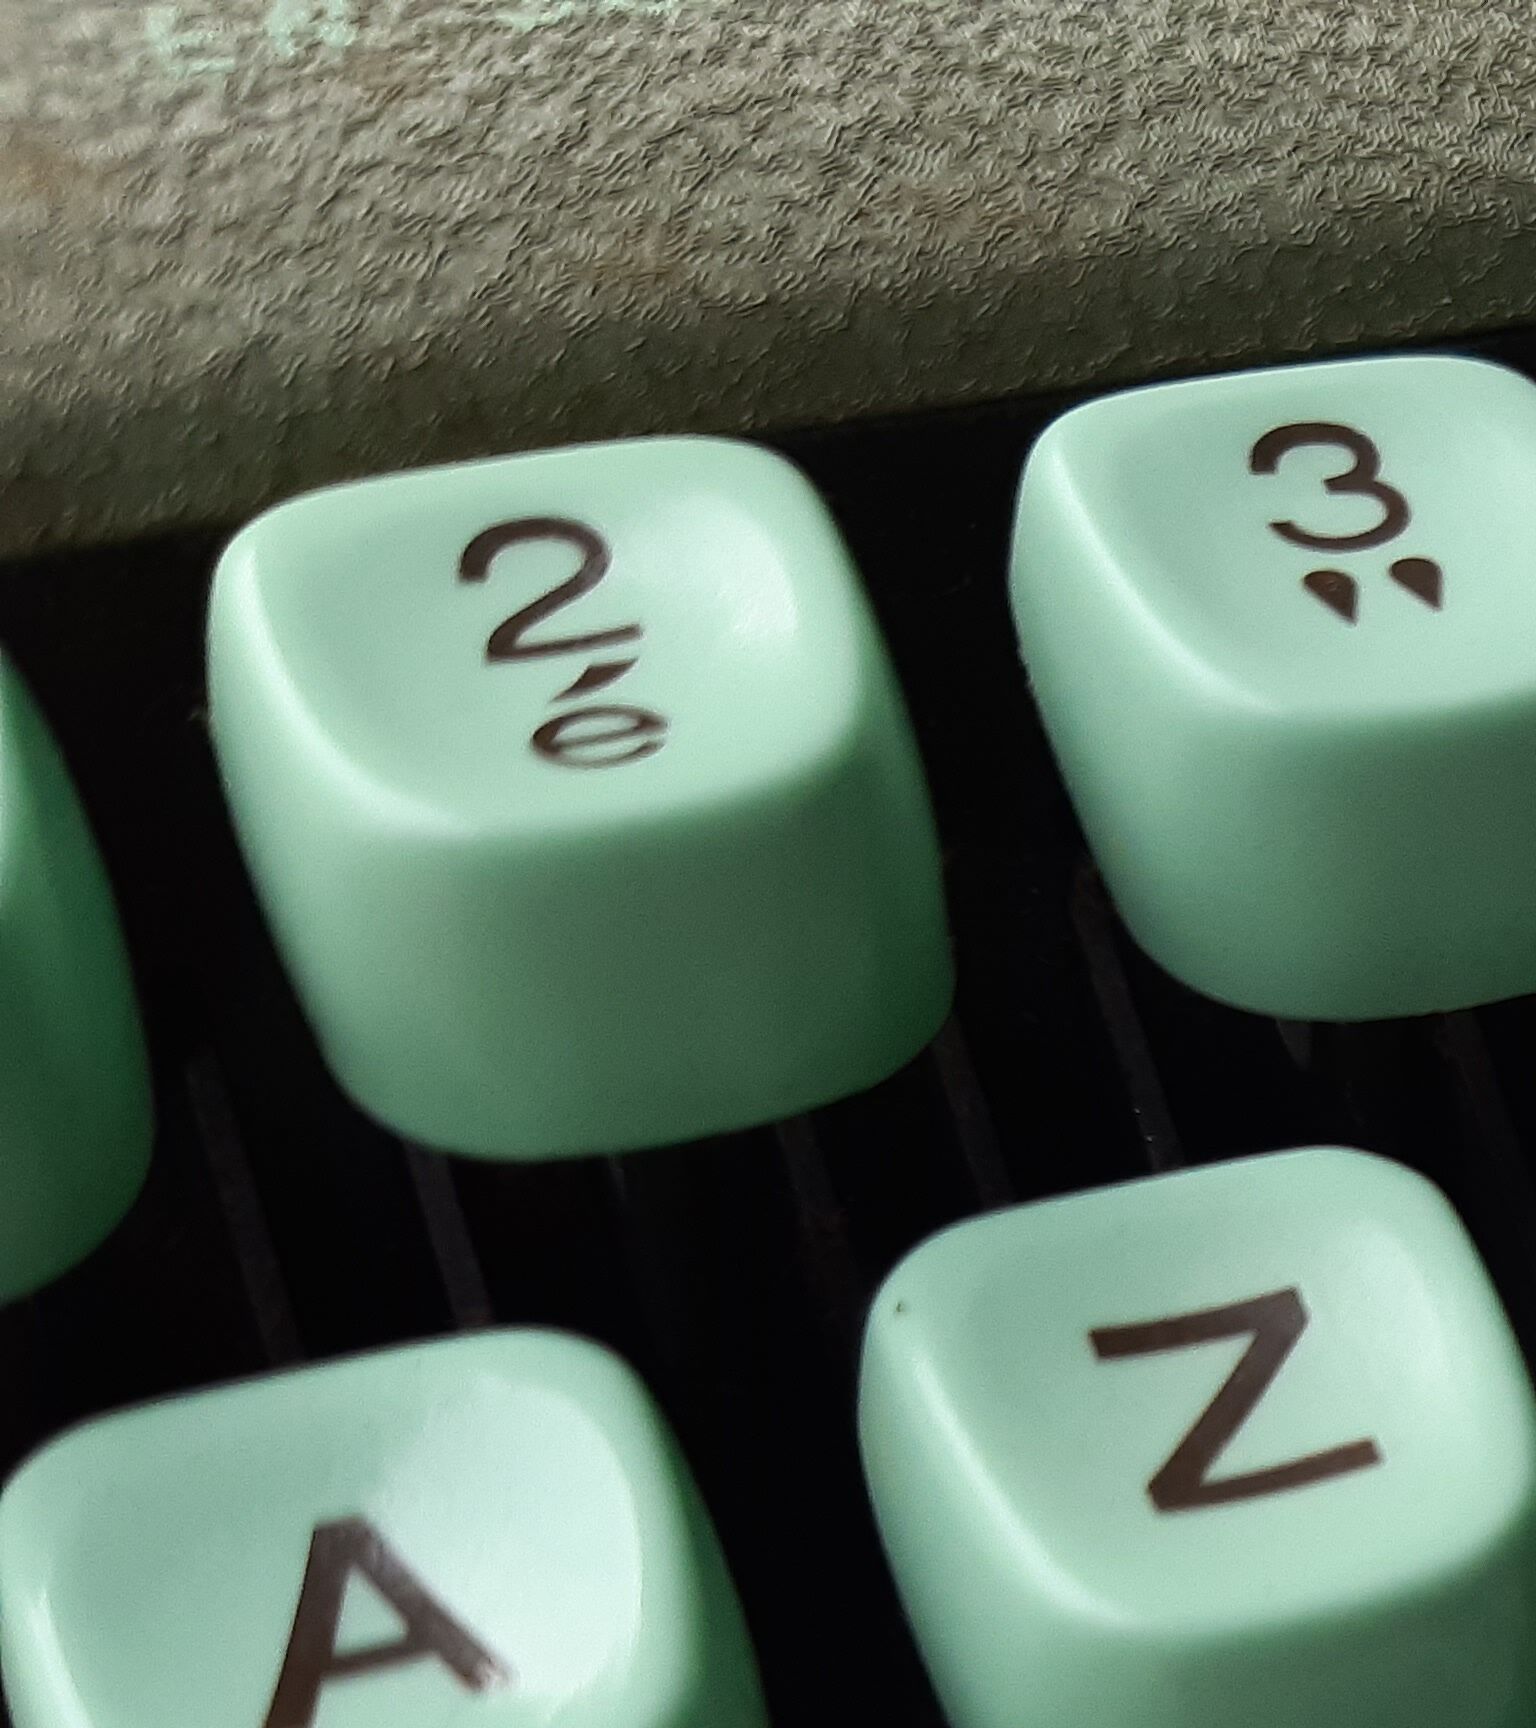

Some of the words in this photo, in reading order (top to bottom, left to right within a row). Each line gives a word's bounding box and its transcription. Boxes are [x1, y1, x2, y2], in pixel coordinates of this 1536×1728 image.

[1249, 422, 1409, 551] 3
[458, 516, 643, 663] 2
[1087, 1288, 1379, 1513] Z
